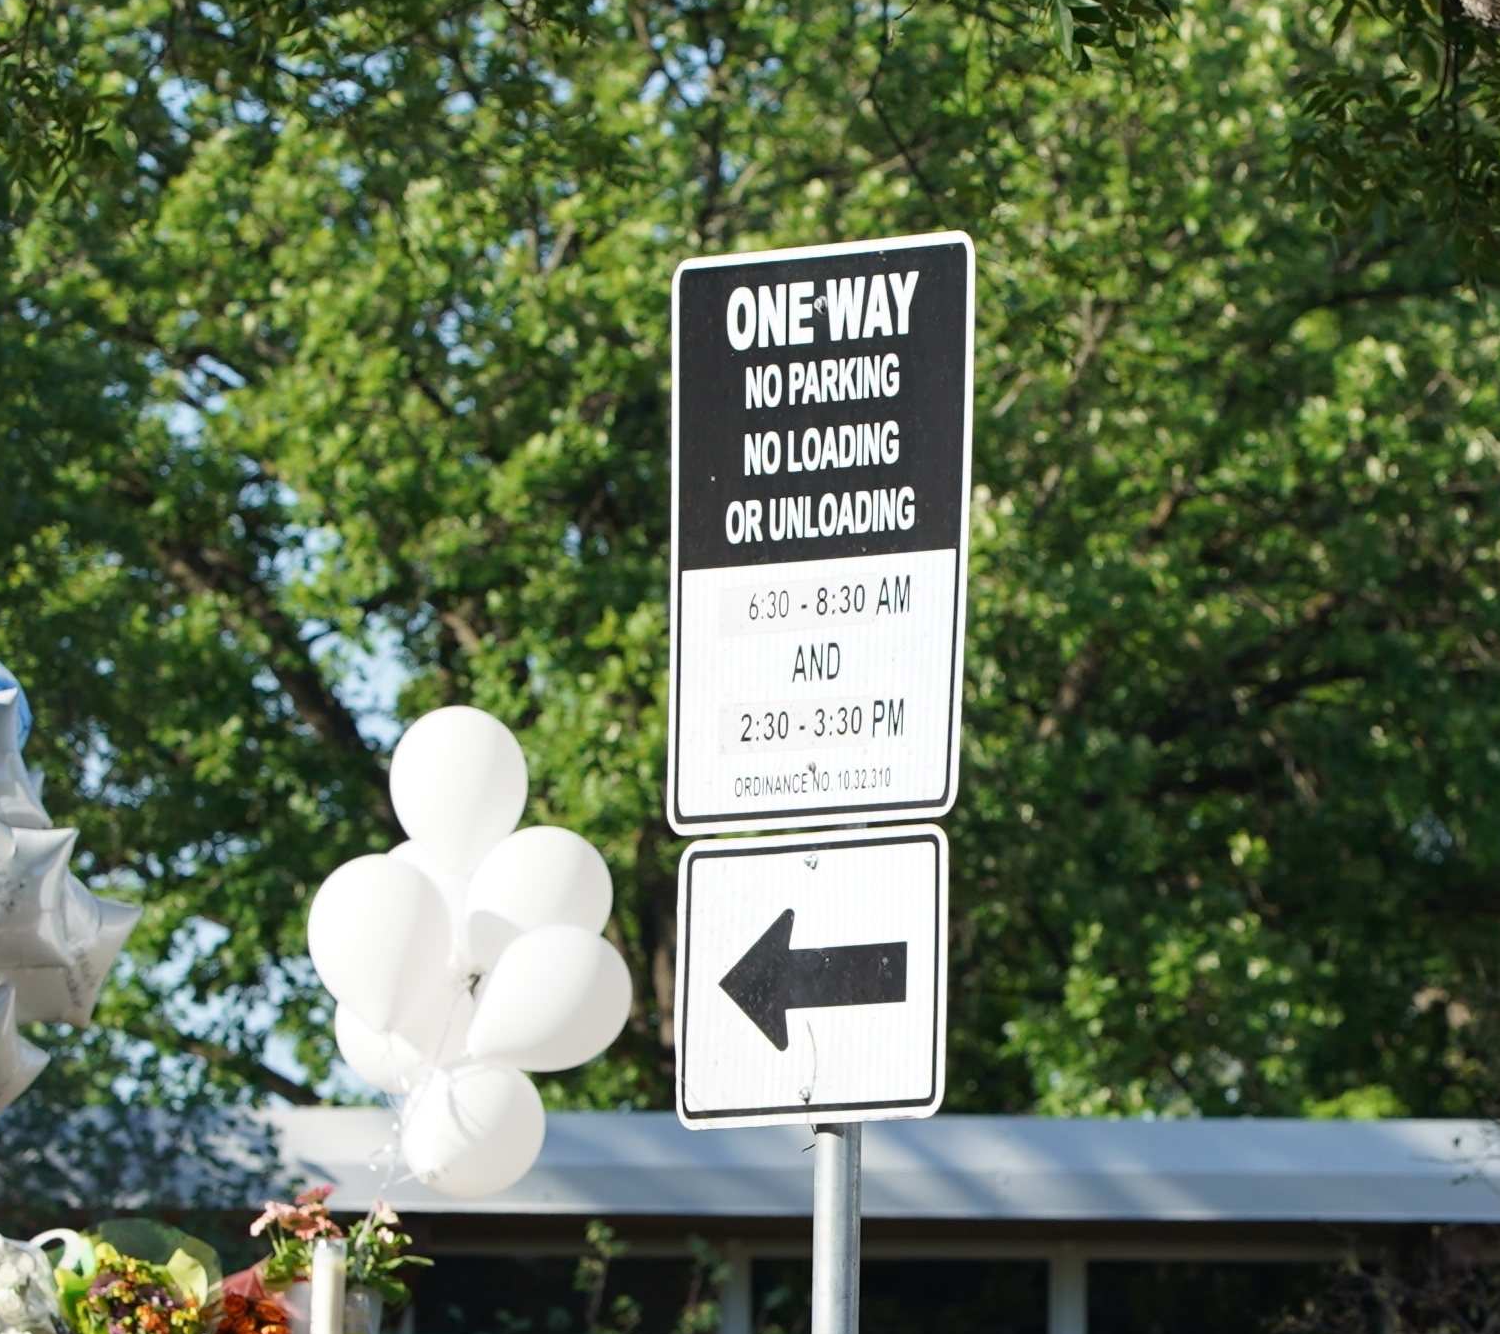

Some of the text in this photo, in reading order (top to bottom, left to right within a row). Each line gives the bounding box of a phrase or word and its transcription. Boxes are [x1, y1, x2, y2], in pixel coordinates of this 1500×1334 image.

[727, 271, 920, 350] ONE WAY
[746, 353, 899, 409] NO PARKING
[745, 421, 899, 475] NO LOADING
[726, 486, 915, 544] OR UNLOADING
[749, 590, 789, 620] 6:30
[817, 585, 865, 615] 8:30
[876, 575, 910, 614] AM
[793, 643, 840, 682] AND
[741, 711, 788, 741] 2:30
[814, 706, 862, 736] 3:30
[873, 699, 904, 737] PM
[735, 767, 890, 797] ORDINANCE NO. 10.32.310
